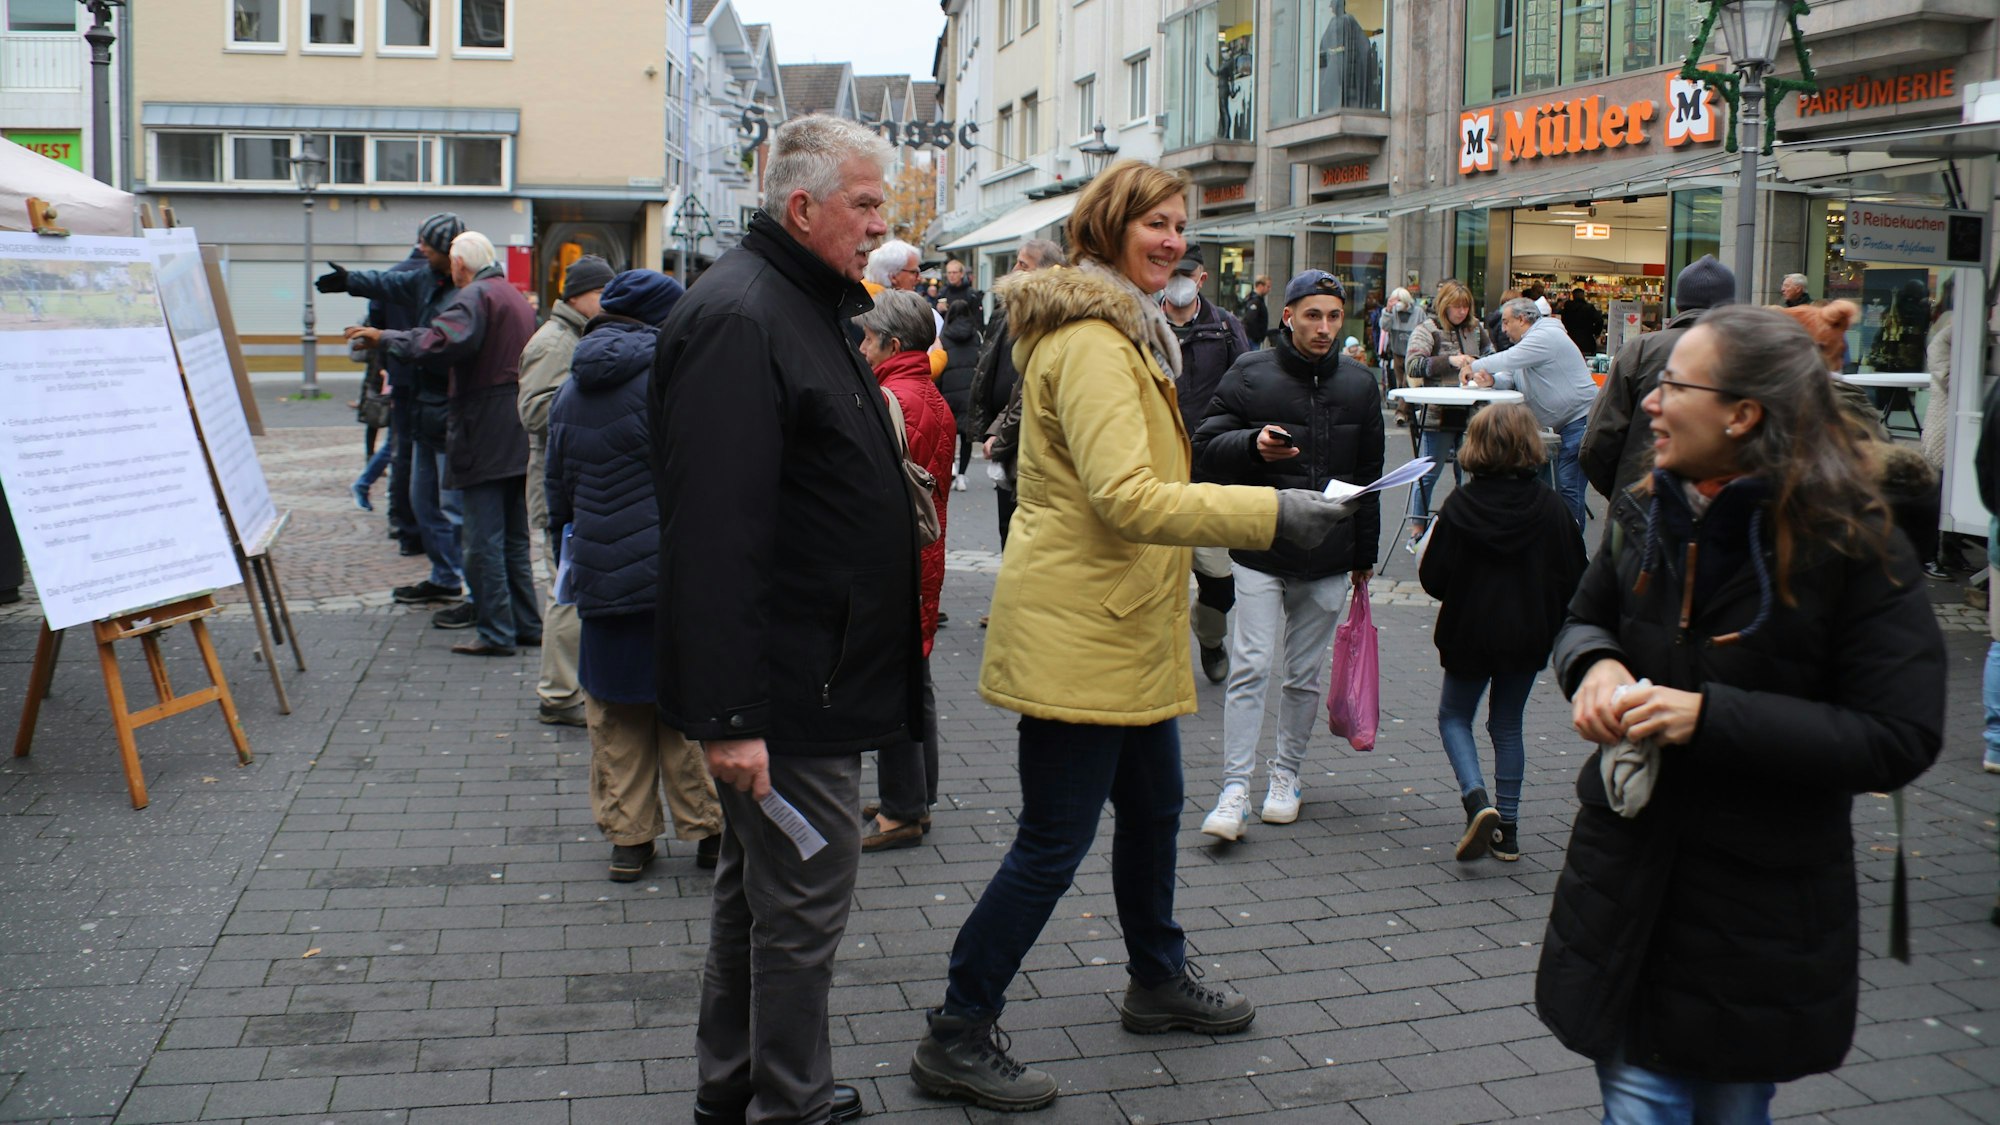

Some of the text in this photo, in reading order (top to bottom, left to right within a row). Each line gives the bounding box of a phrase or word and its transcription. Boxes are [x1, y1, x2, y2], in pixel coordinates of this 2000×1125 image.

[1795, 68, 1955, 118] PARFÜMERIE
[1467, 88, 1702, 161] M Müller M
[1322, 164, 1369, 187] DROGERIE
[1852, 210, 1945, 231] 3 Reibekuchen
[1863, 237, 1936, 256] Portion Apfelmus
[1553, 257, 1570, 269] Tee
